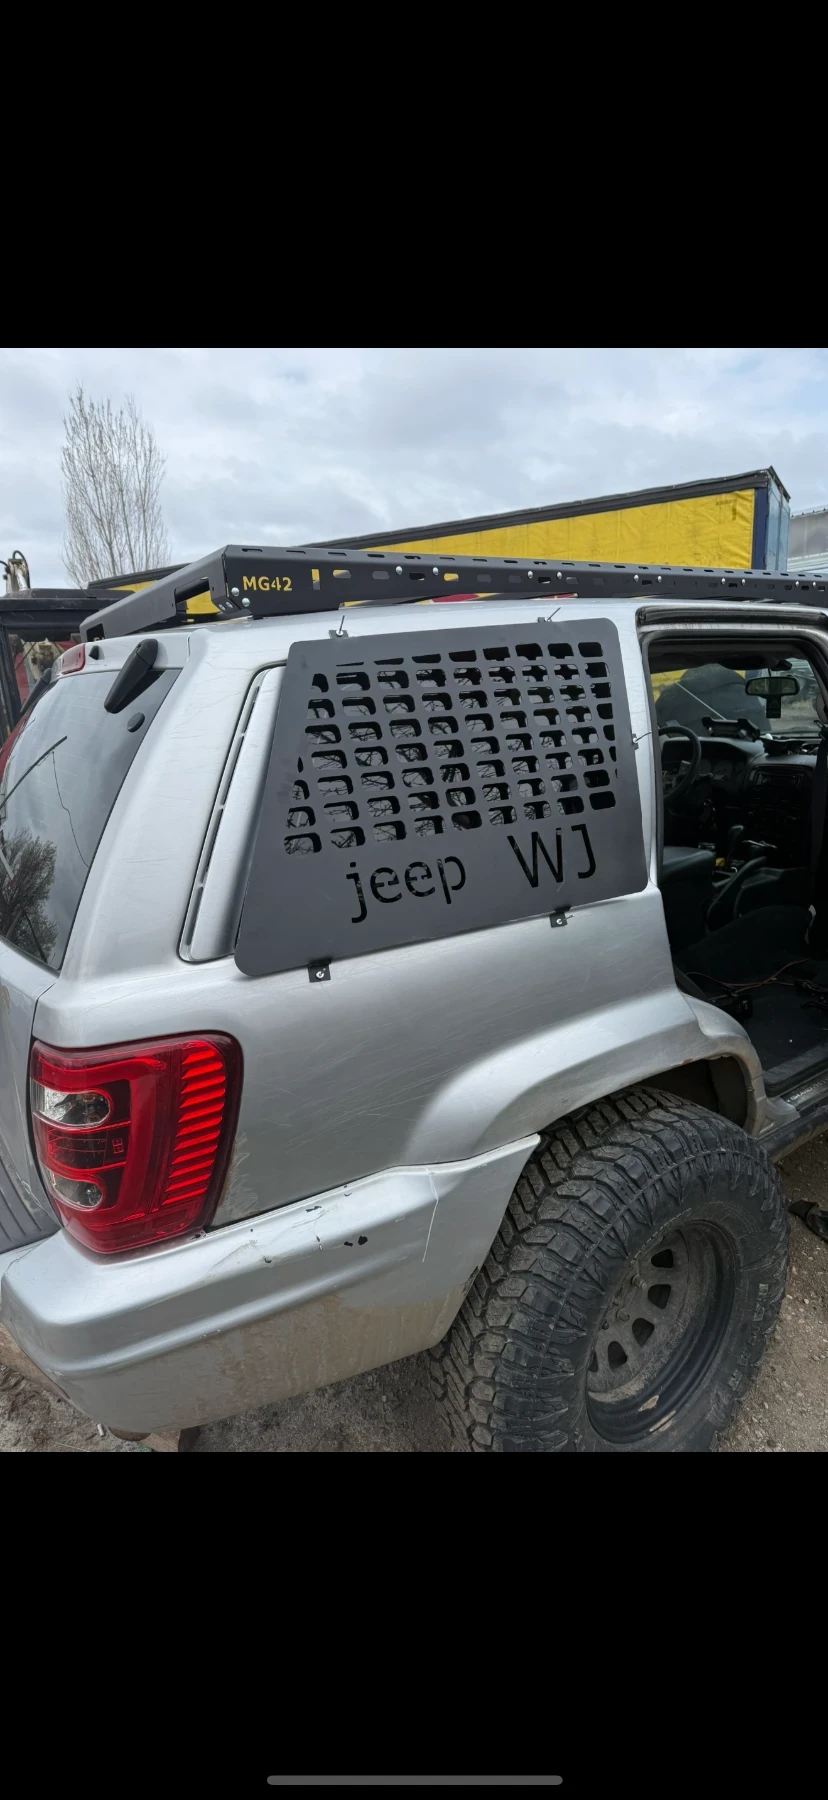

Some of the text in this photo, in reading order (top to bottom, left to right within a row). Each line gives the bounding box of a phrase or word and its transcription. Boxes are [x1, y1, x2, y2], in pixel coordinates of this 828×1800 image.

[242, 575, 293, 592] MG42
[346, 823, 596, 923] jeep WJ
